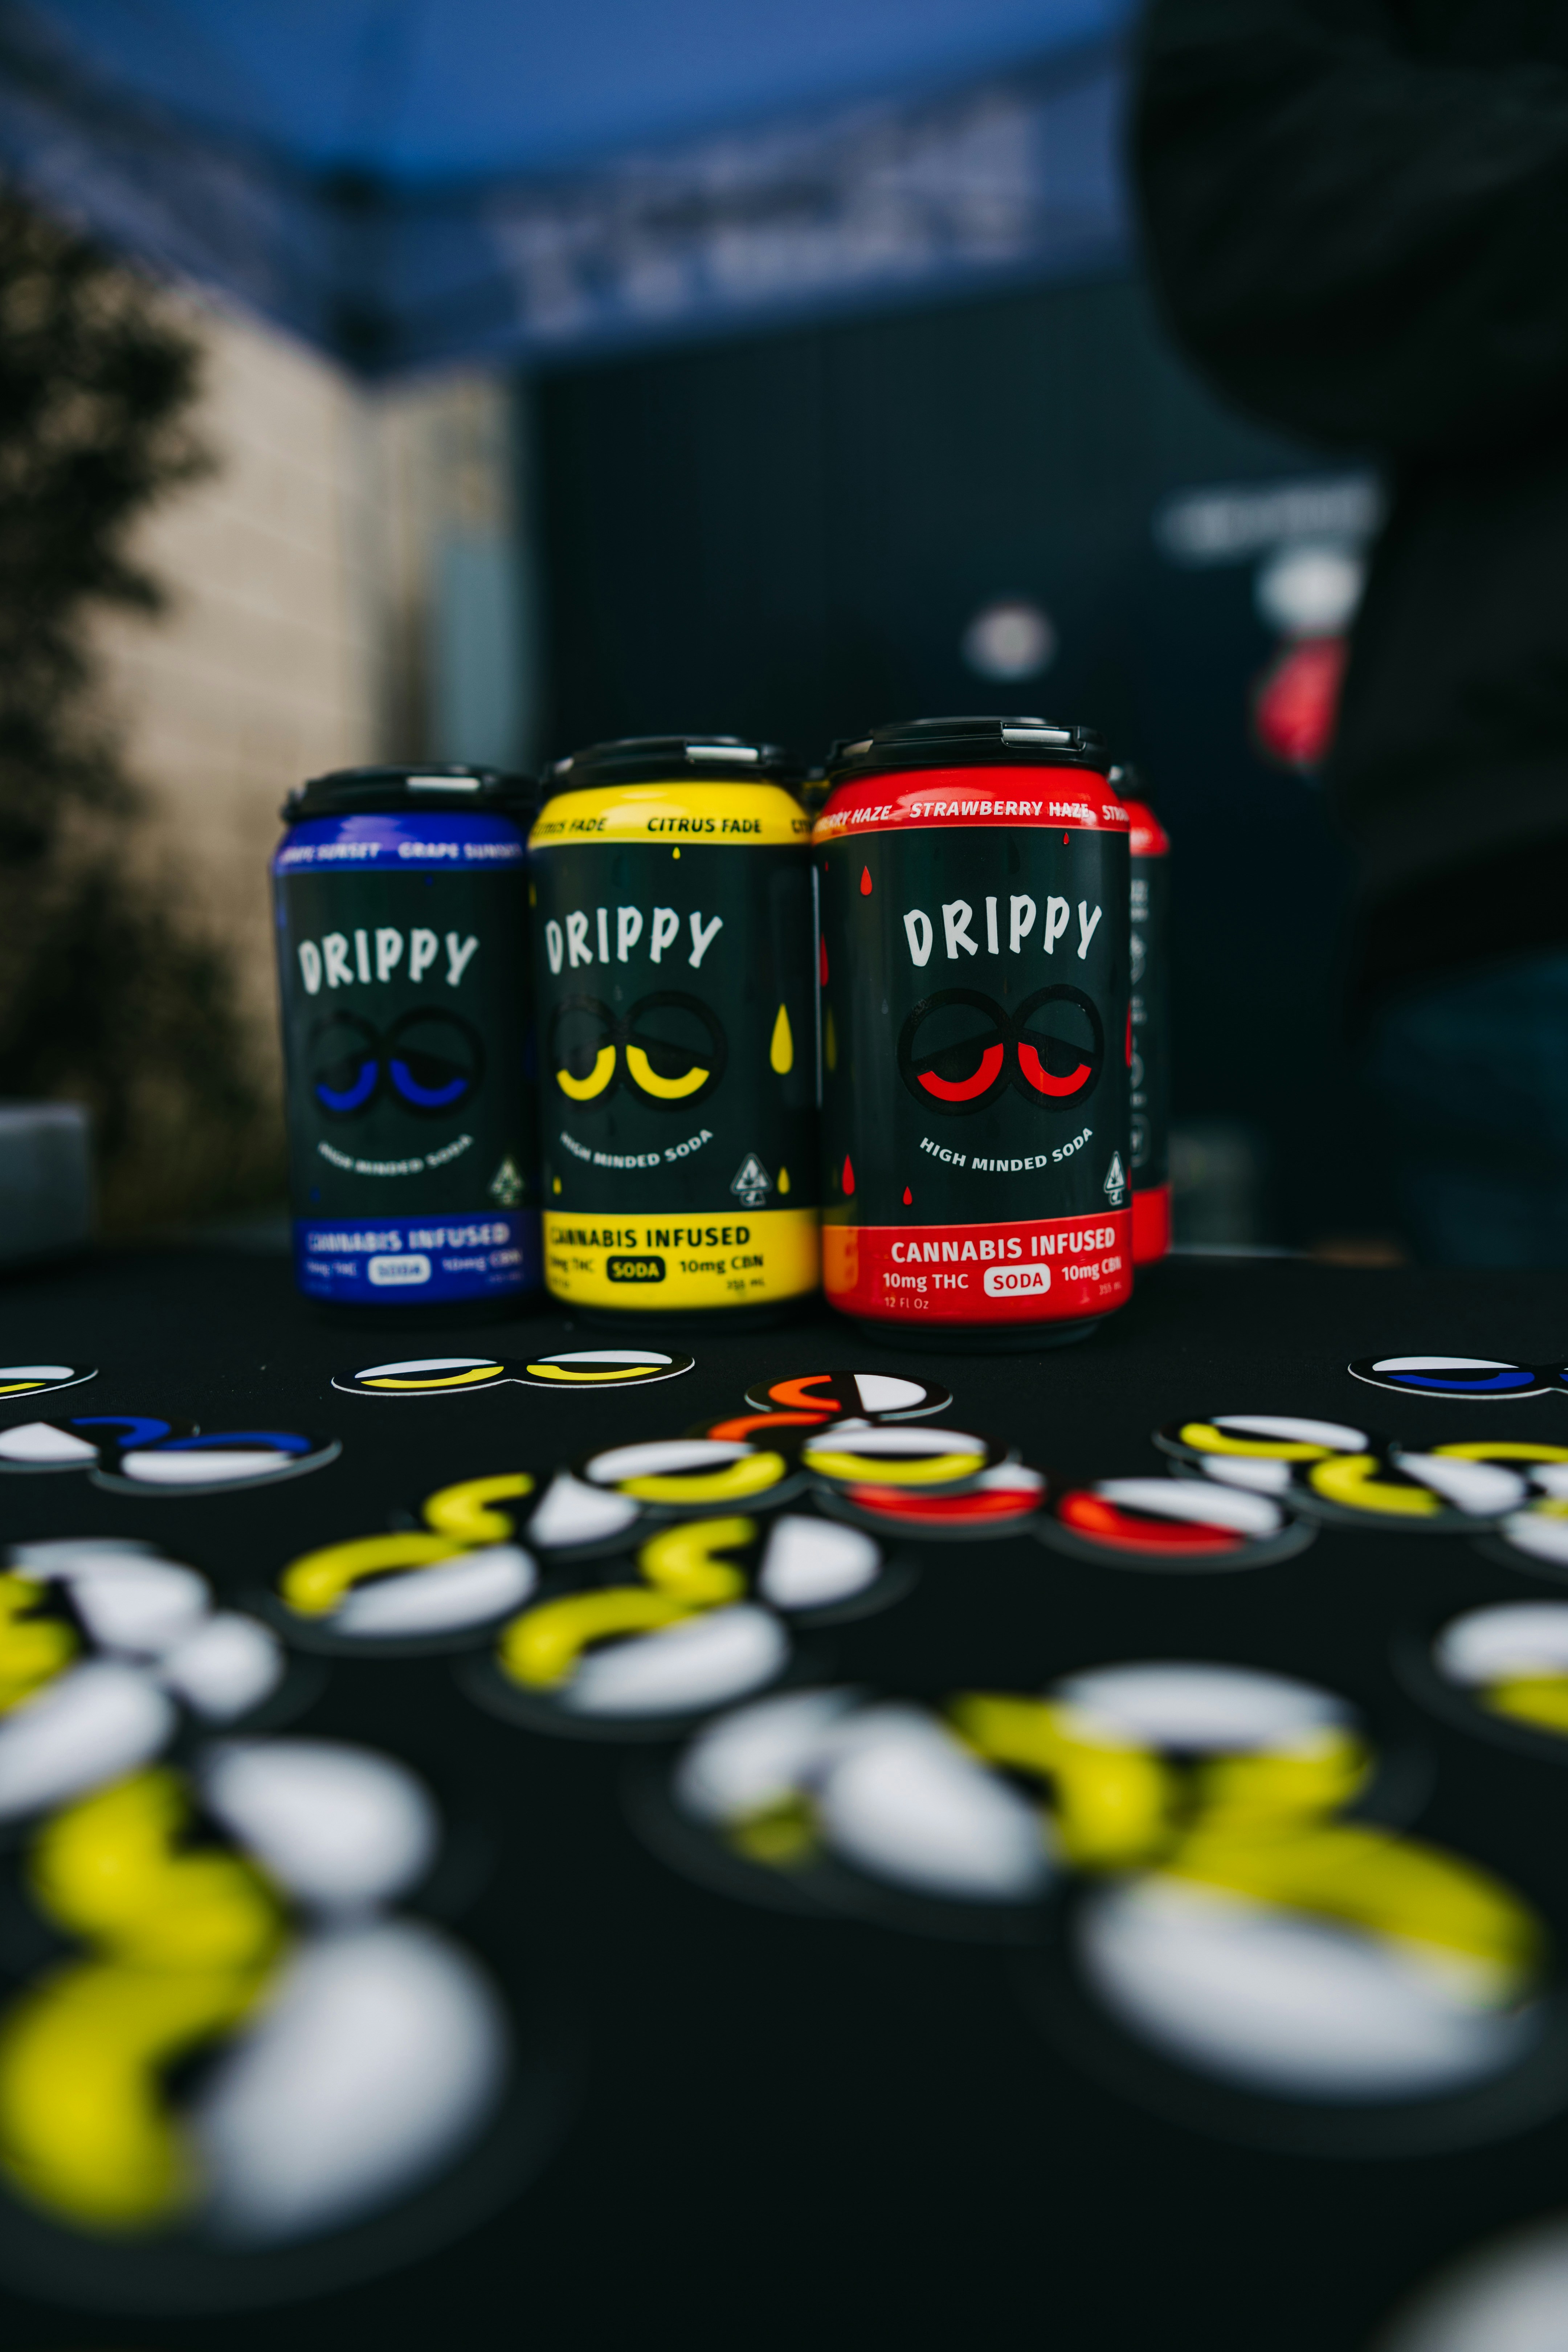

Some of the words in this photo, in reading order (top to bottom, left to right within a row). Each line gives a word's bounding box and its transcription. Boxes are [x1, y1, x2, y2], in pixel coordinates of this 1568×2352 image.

[851, 805, 893, 824] HAZE
[909, 801, 1043, 818] STRAWBERRY
[1049, 803, 1089, 818] HAZE
[569, 817, 608, 832] FADE
[647, 817, 715, 833] CITRUS
[722, 818, 761, 833] FADE
[398, 842, 459, 859] GRAPE
[545, 906, 723, 975] DRIPPY
[903, 894, 1102, 967] DRIPPY
[298, 927, 479, 995] DRIPPY
[560, 1130, 591, 1161] HIGH
[593, 1151, 660, 1169] MINDED
[664, 1129, 713, 1162] SODA
[919, 1137, 966, 1167] HIGH
[971, 1155, 1047, 1172] MINDED
[1052, 1127, 1093, 1161] SODA
[408, 1222, 510, 1249] INFUSED
[551, 1225, 637, 1248] CANNABIS
[646, 1226, 751, 1248] INFUSED
[891, 1237, 1022, 1263] CANNABIS
[1031, 1227, 1115, 1257] INFUSED
[612, 1261, 660, 1279] SODA
[680, 1259, 726, 1275] 10mg
[731, 1254, 764, 1270] CBN
[1061, 1263, 1100, 1281] 10mg
[882, 1272, 928, 1293] 10mg
[931, 1273, 969, 1289] THC
[993, 1273, 1044, 1291] SODA
[884, 1296, 896, 1308] 12
